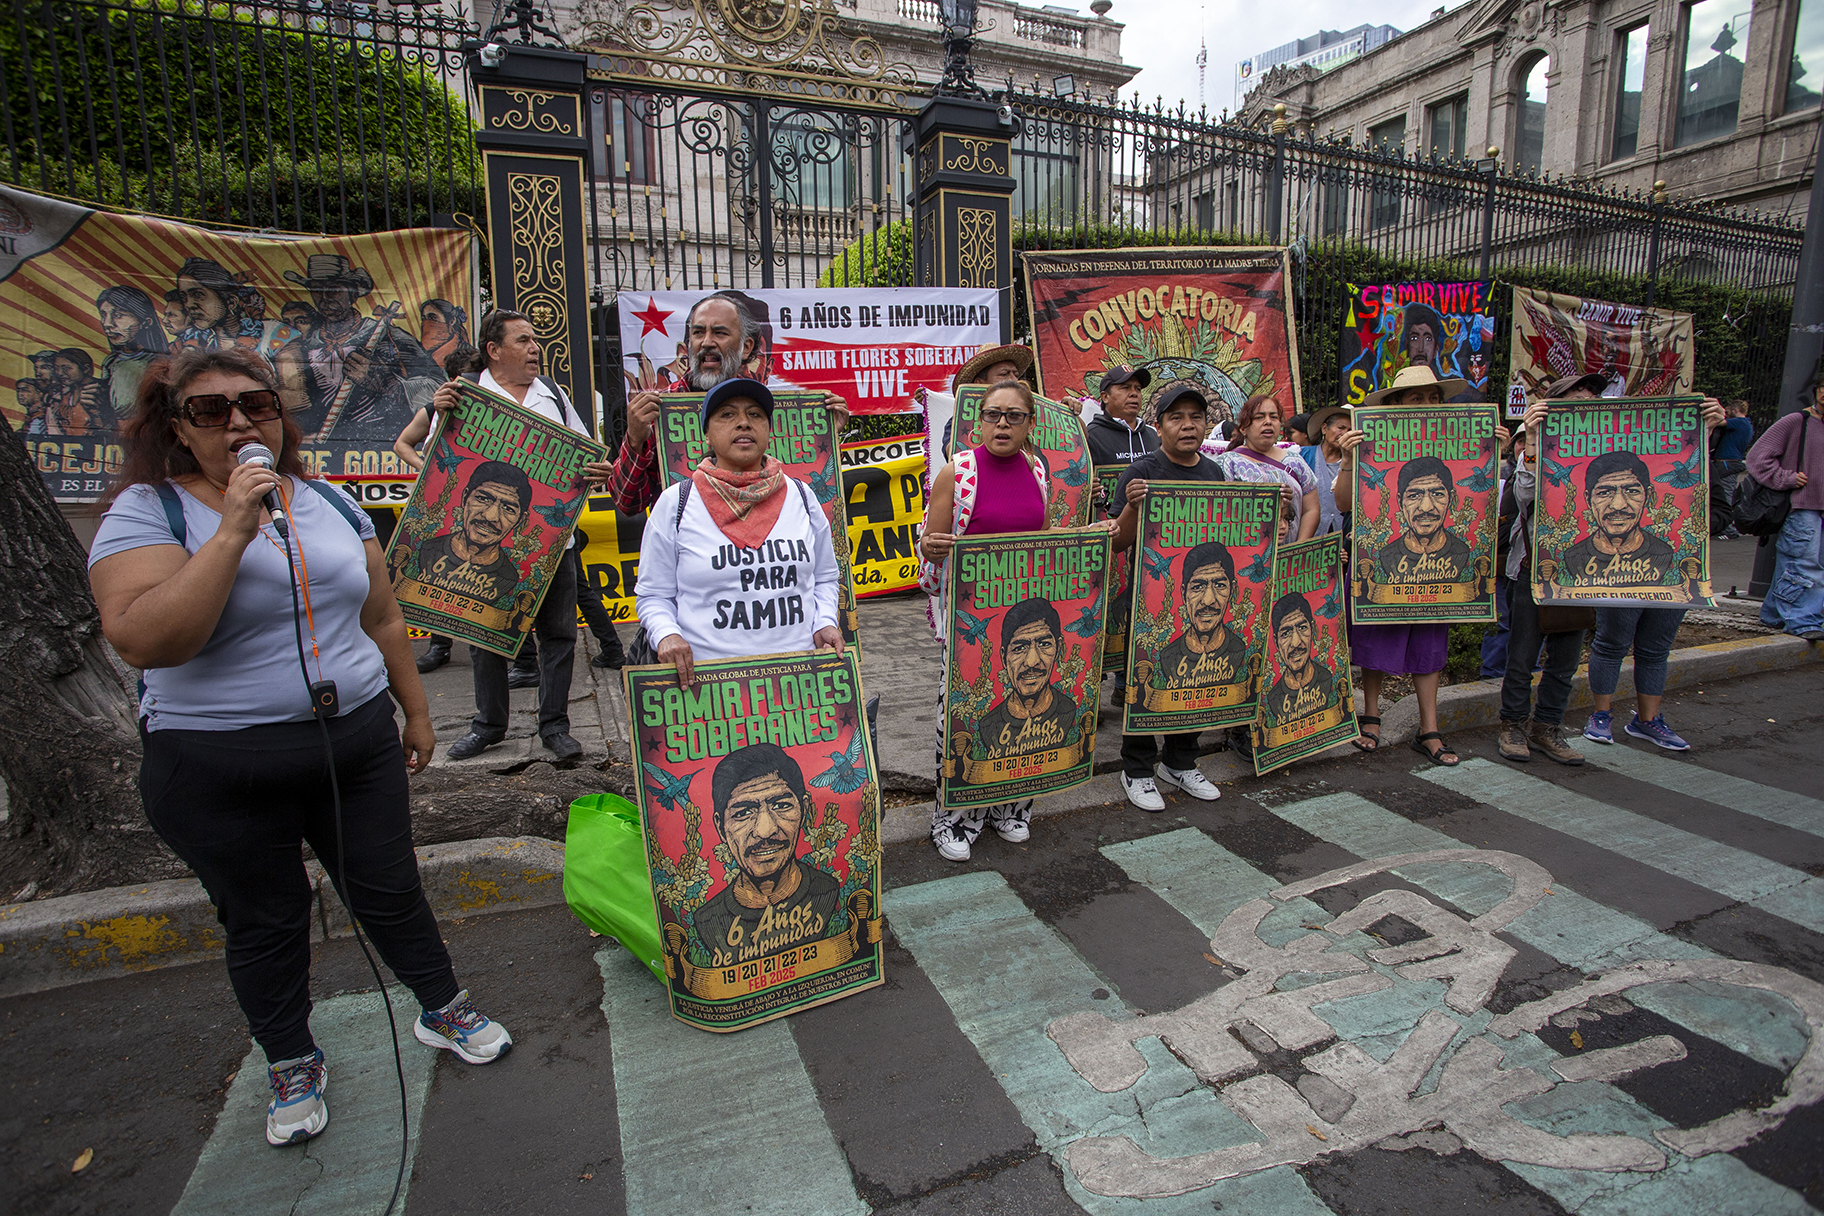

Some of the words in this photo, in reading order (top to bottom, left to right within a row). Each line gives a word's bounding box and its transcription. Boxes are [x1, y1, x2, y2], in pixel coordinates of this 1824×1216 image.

[1032, 262, 1078, 274] JORNADAS
[1080, 262, 1092, 272] EN
[1094, 261, 1130, 271] DEFENSA
[1132, 260, 1148, 270] DEL
[1150, 260, 1203, 270] TERRITORIO
[1205, 259, 1211, 268] Y
[1212, 259, 1223, 268] LA
[1224, 258, 1252, 268] MADRE
[1252, 258, 1280, 267] TIERRA
[780, 307, 792, 329] 6
[800, 302, 852, 328] AÑOS
[859, 305, 882, 328] DE
[888, 304, 990, 327] IMPUNIDAD
[1068, 285, 1257, 350] CONVOCATORIA
[1577, 302, 1614, 322] SAMIR
[1614, 306, 1642, 326] VIVE
[782, 350, 836, 370] SAMIR
[842, 348, 900, 368] FLORES
[854, 369, 910, 398] VIVE
[453, 394, 524, 445] SAMIR
[1362, 419, 1421, 441] SAMIR
[1426, 417, 1493, 440] FLORES
[1546, 411, 1612, 436] SAMIR
[1618, 407, 1697, 433] FLORES
[1374, 439, 1480, 462] SOBERANES
[1558, 431, 1682, 458] SOBERANES
[298, 450, 332, 475] DE
[456, 425, 574, 494] SOBERANES
[60, 480, 80, 492] ES
[83, 480, 105, 492] EL
[342, 480, 410, 502] ÑOS
[1149, 496, 1208, 522] SAMIR
[1212, 498, 1273, 522] FLORES
[989, 543, 1014, 552] JORNADA
[1015, 541, 1035, 549] GLOBAL
[1042, 540, 1065, 548] JUSTICIA
[1160, 522, 1261, 547] SOBERANES
[711, 538, 810, 570] JUSTICIA
[961, 550, 1027, 582] SAMIR
[1033, 545, 1103, 577] FLORES
[1290, 544, 1337, 577] FLORES
[1398, 555, 1408, 573] 6
[1412, 552, 1452, 574] Años
[1586, 556, 1598, 576] 6
[1603, 553, 1652, 577] Años
[417, 568, 432, 584] de
[433, 576, 498, 600] impunidad
[432, 554, 448, 574] 6
[448, 566, 497, 590] Años
[740, 564, 798, 592] PARA
[1273, 568, 1328, 602] BERANES
[1388, 573, 1399, 583] de
[1403, 566, 1458, 583] impunidad
[1574, 576, 1588, 586] de
[1592, 568, 1660, 586] impunidad
[974, 572, 1089, 609] SOBERANES
[430, 600, 443, 610] FEB
[444, 604, 464, 616] 2025
[712, 594, 804, 630] SAMIR
[692, 672, 718, 684] NADA
[718, 670, 748, 681] GLOBAL
[749, 669, 760, 678] DE
[760, 666, 792, 678] JUSTICIA
[793, 664, 812, 672] PARA
[1167, 677, 1178, 689] de
[1182, 666, 1234, 688] impunidad
[1177, 656, 1187, 676] 6
[1192, 652, 1229, 677] Años
[642, 680, 744, 727] SAMIR
[749, 668, 852, 714] FLORES
[1185, 700, 1196, 709] FEB
[1198, 699, 1213, 708] 2025
[1276, 713, 1286, 726] de
[1288, 692, 1326, 722] impunidad
[1282, 694, 1291, 712] 6
[1294, 685, 1321, 710] Años
[666, 706, 838, 763] SOBERANES
[988, 746, 1001, 759] de
[1005, 728, 1064, 757] impunidad
[999, 722, 1011, 745] 6
[1016, 716, 1058, 745] Años
[1294, 730, 1302, 740] FEB
[1302, 725, 1316, 736] 2025
[1009, 768, 1022, 778] FEB
[1024, 765, 1042, 776] 2025
[726, 915, 744, 946] 6
[750, 901, 812, 944] Años
[712, 949, 732, 968] de
[738, 912, 824, 962] impunidad
[749, 976, 767, 992] FEB
[770, 966, 796, 986] 2025
[682, 1007, 694, 1017] POR
[704, 1002, 764, 1020] RECONSTITUCIÓN
[765, 994, 798, 1007] INTEGRAL
[800, 990, 808, 998] DE
[809, 981, 841, 996] NUESTROS
[842, 971, 868, 985] PUEBLOS
[687, 1002, 714, 1013] JUSTICIA
[714, 1000, 744, 1013] VENDRÁ
[744, 1000, 754, 1008] DE
[754, 993, 775, 1004] ABAJO
[788, 986, 797, 994] LA
